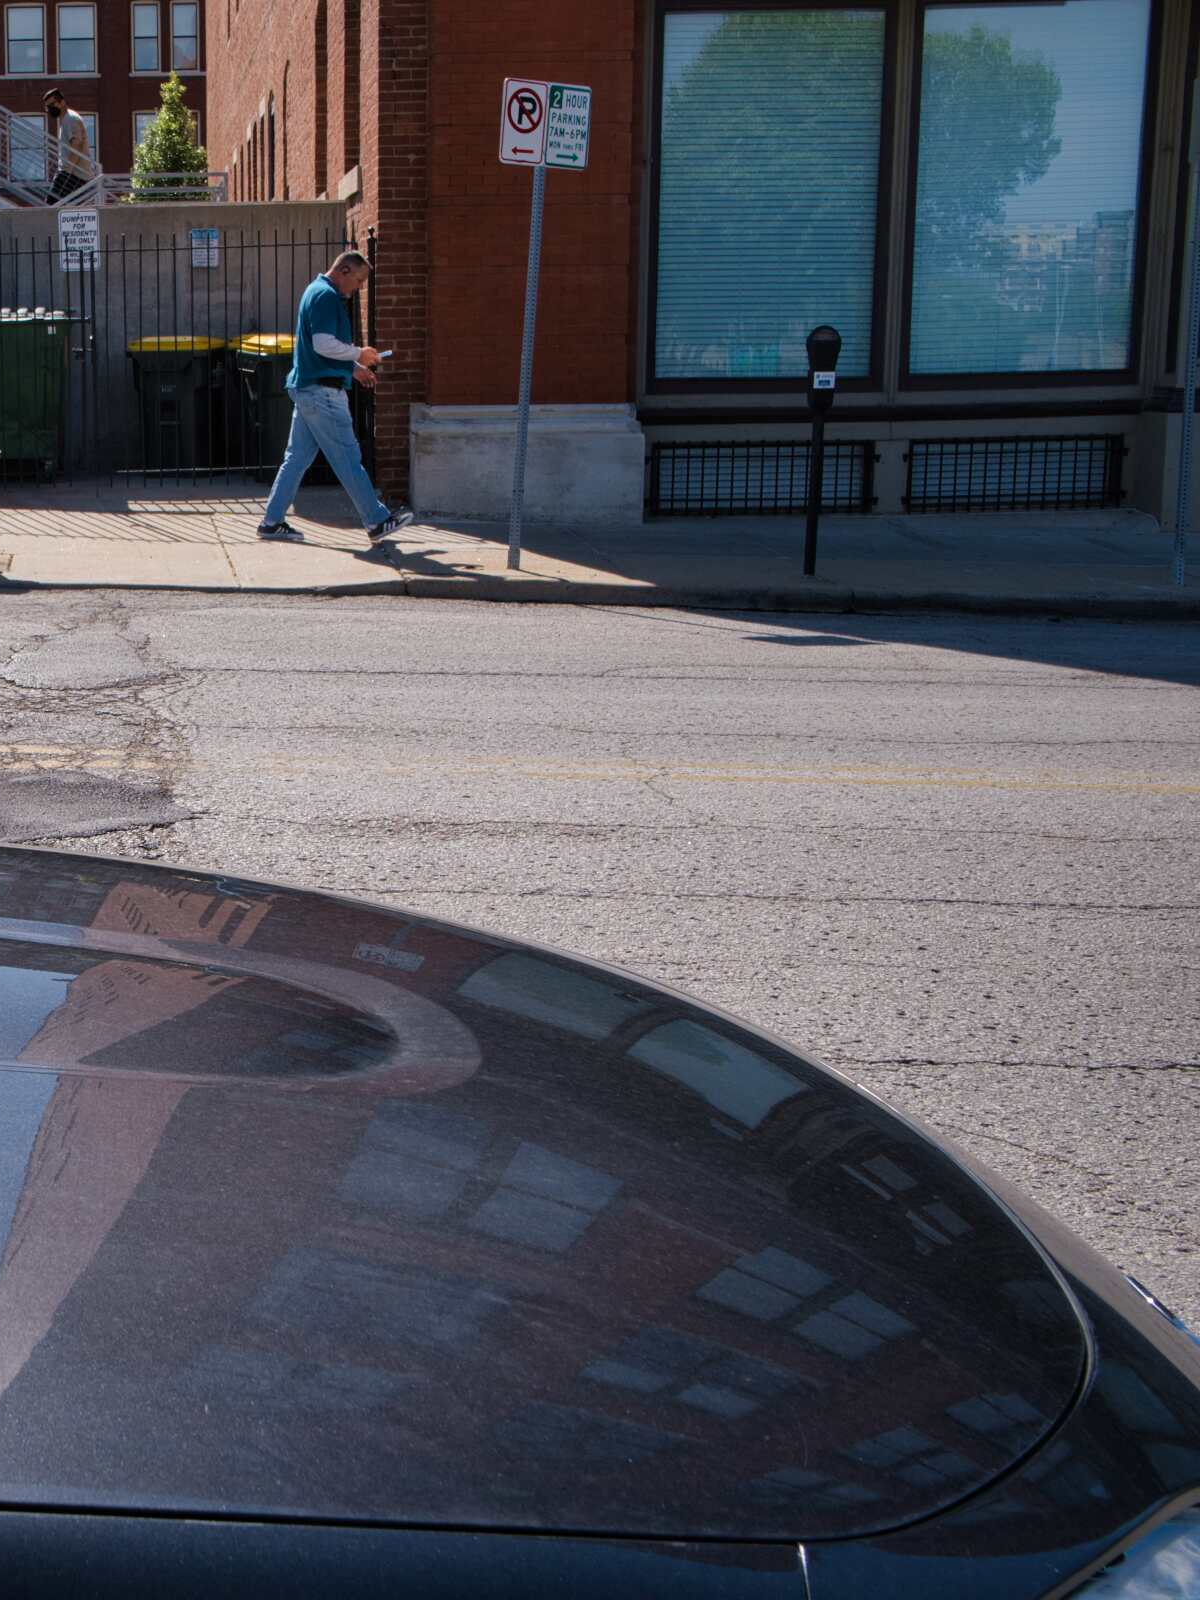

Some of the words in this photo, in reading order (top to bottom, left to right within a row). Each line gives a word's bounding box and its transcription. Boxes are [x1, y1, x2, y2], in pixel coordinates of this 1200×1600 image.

[553, 91, 561, 107] 2
[566, 94, 588, 109] HOUR
[551, 112, 586, 126] PARKING
[550, 127, 586, 140] 7AM-6PM
[62, 215, 96, 223] DUMPSTER
